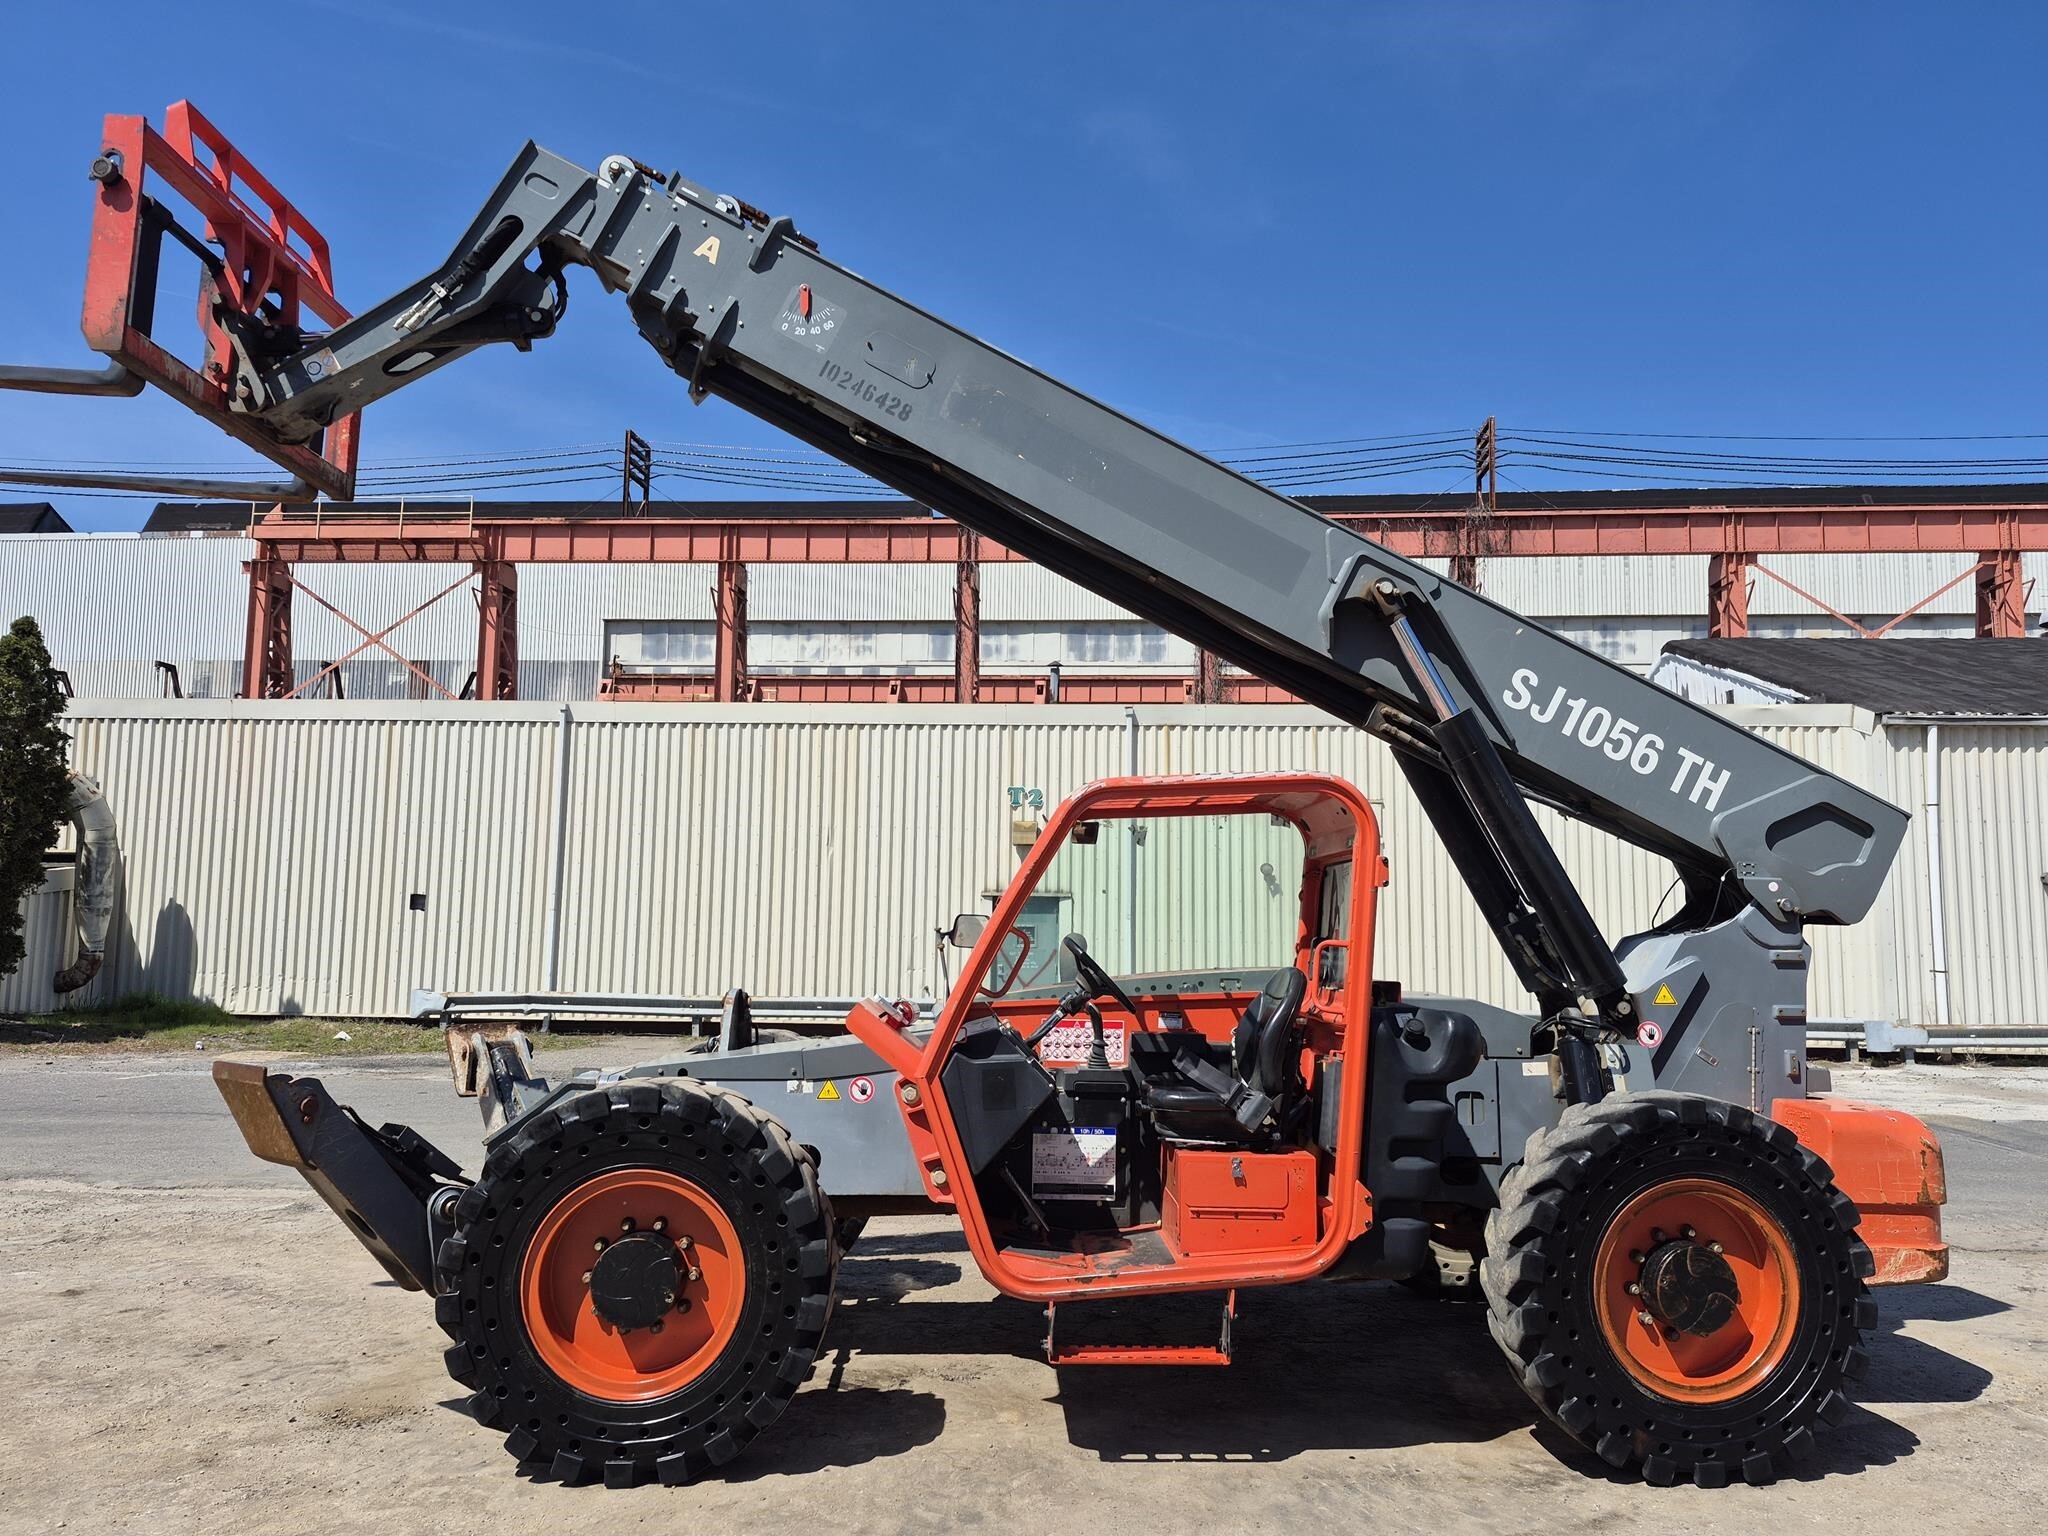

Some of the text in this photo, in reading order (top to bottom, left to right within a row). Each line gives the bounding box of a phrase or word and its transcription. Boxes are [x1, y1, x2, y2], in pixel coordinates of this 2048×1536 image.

[693, 235, 721, 265] A
[781, 320, 835, 336] 0 20 40 60
[818, 360, 913, 422] 10246428
[1502, 668, 1732, 813] SJ1056 TH
[1007, 786, 1044, 808] T2
